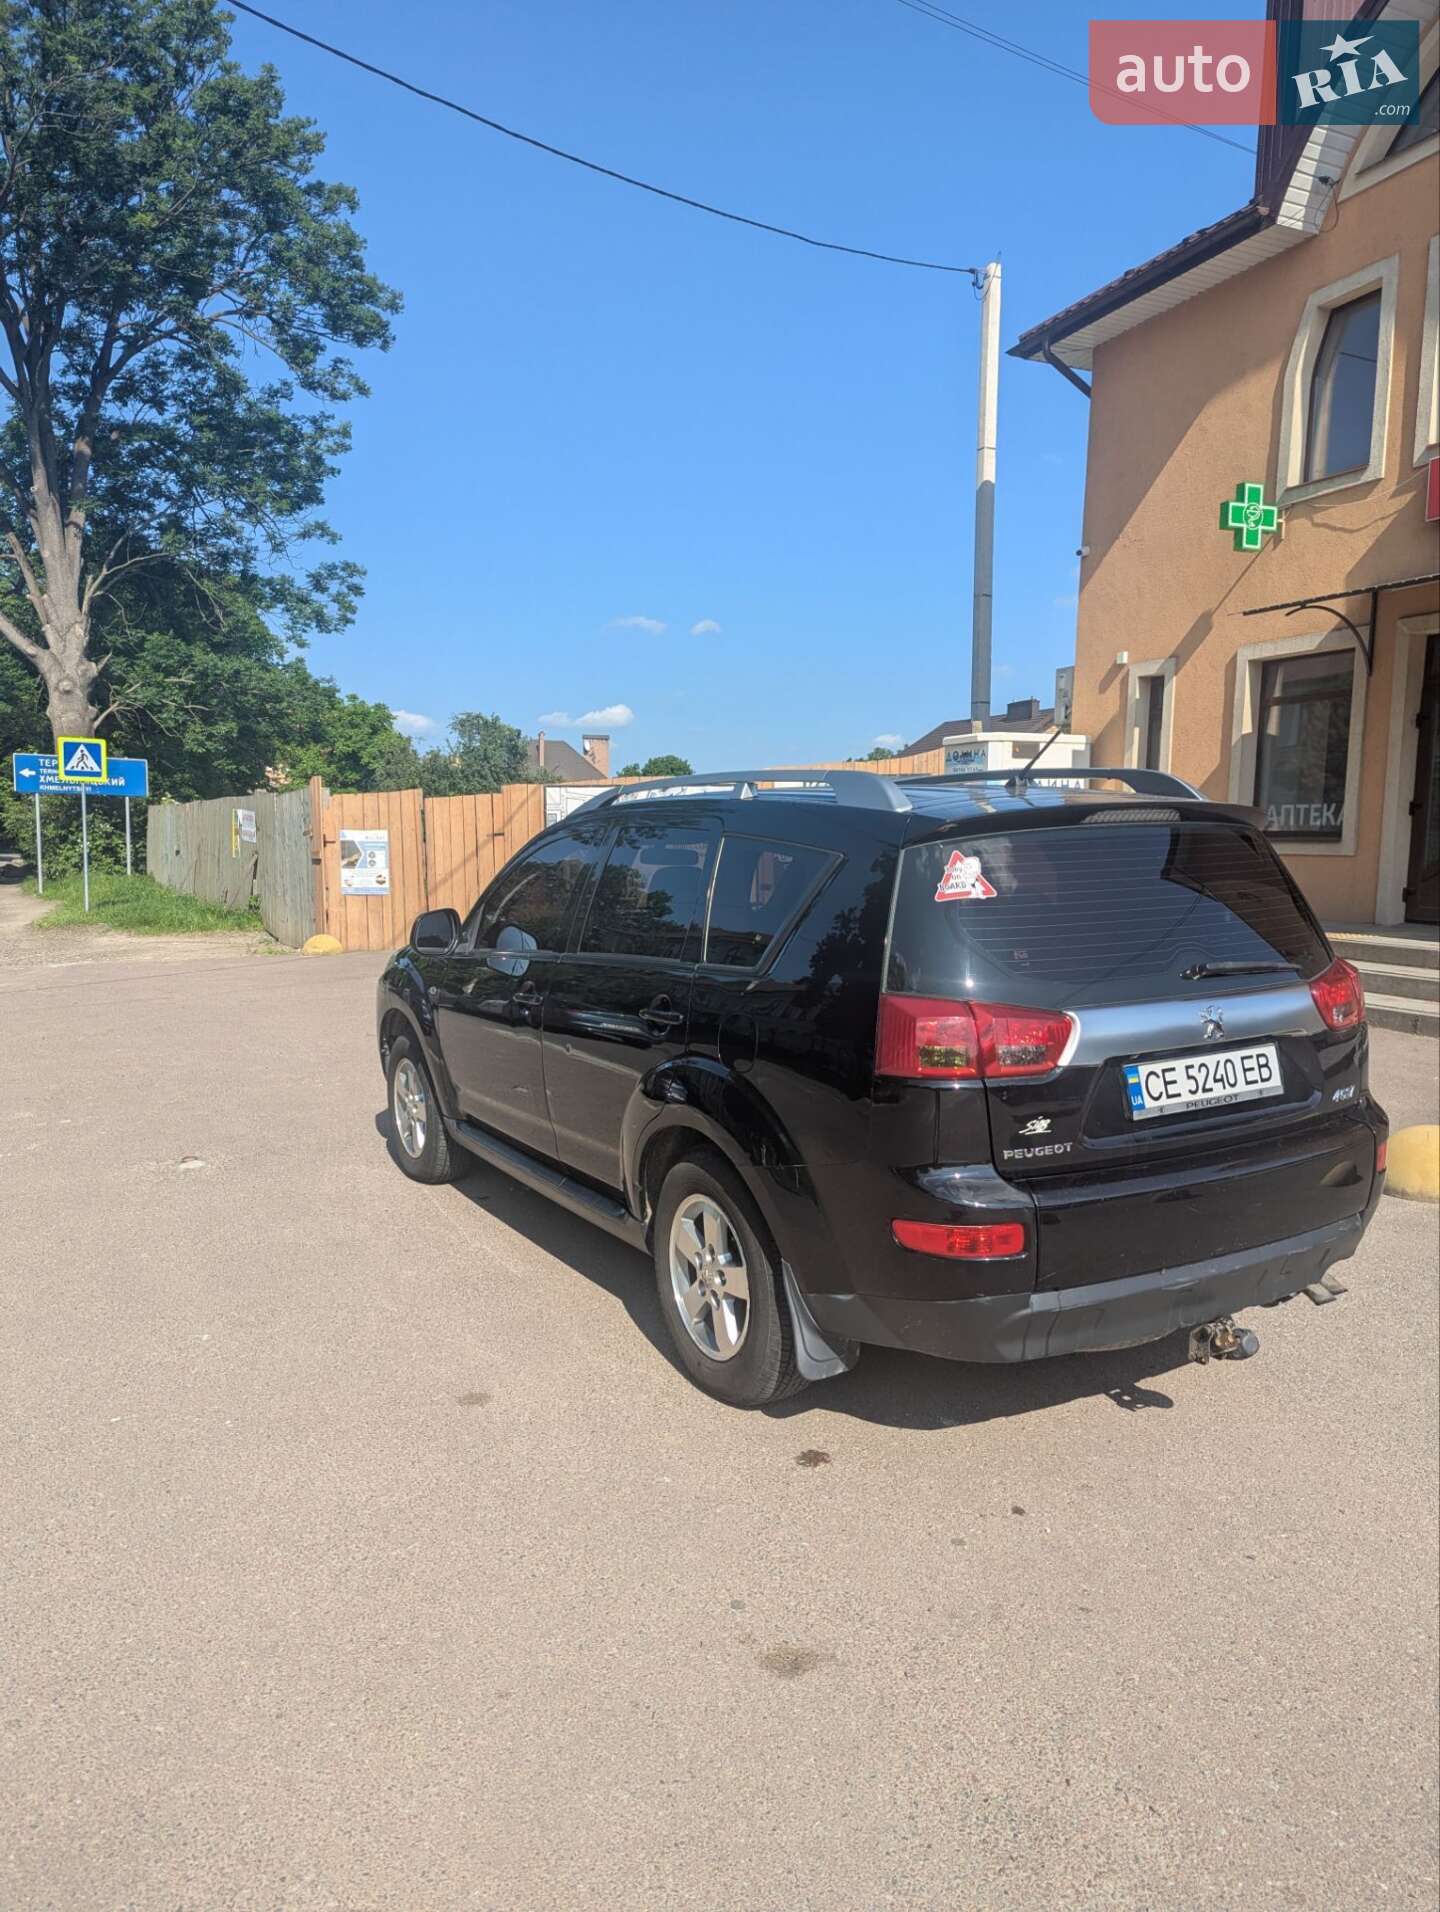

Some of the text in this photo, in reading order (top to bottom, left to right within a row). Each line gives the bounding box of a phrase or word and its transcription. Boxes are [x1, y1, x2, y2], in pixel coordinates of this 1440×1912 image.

[38, 758, 58, 767] ТЕР
[1145, 1053, 1273, 1102] CE 5240 EB
[1131, 1095, 1143, 1106] UA
[1185, 1093, 1240, 1110] PEUGEOT
[1003, 1142, 1073, 1160] PEUGEOT
